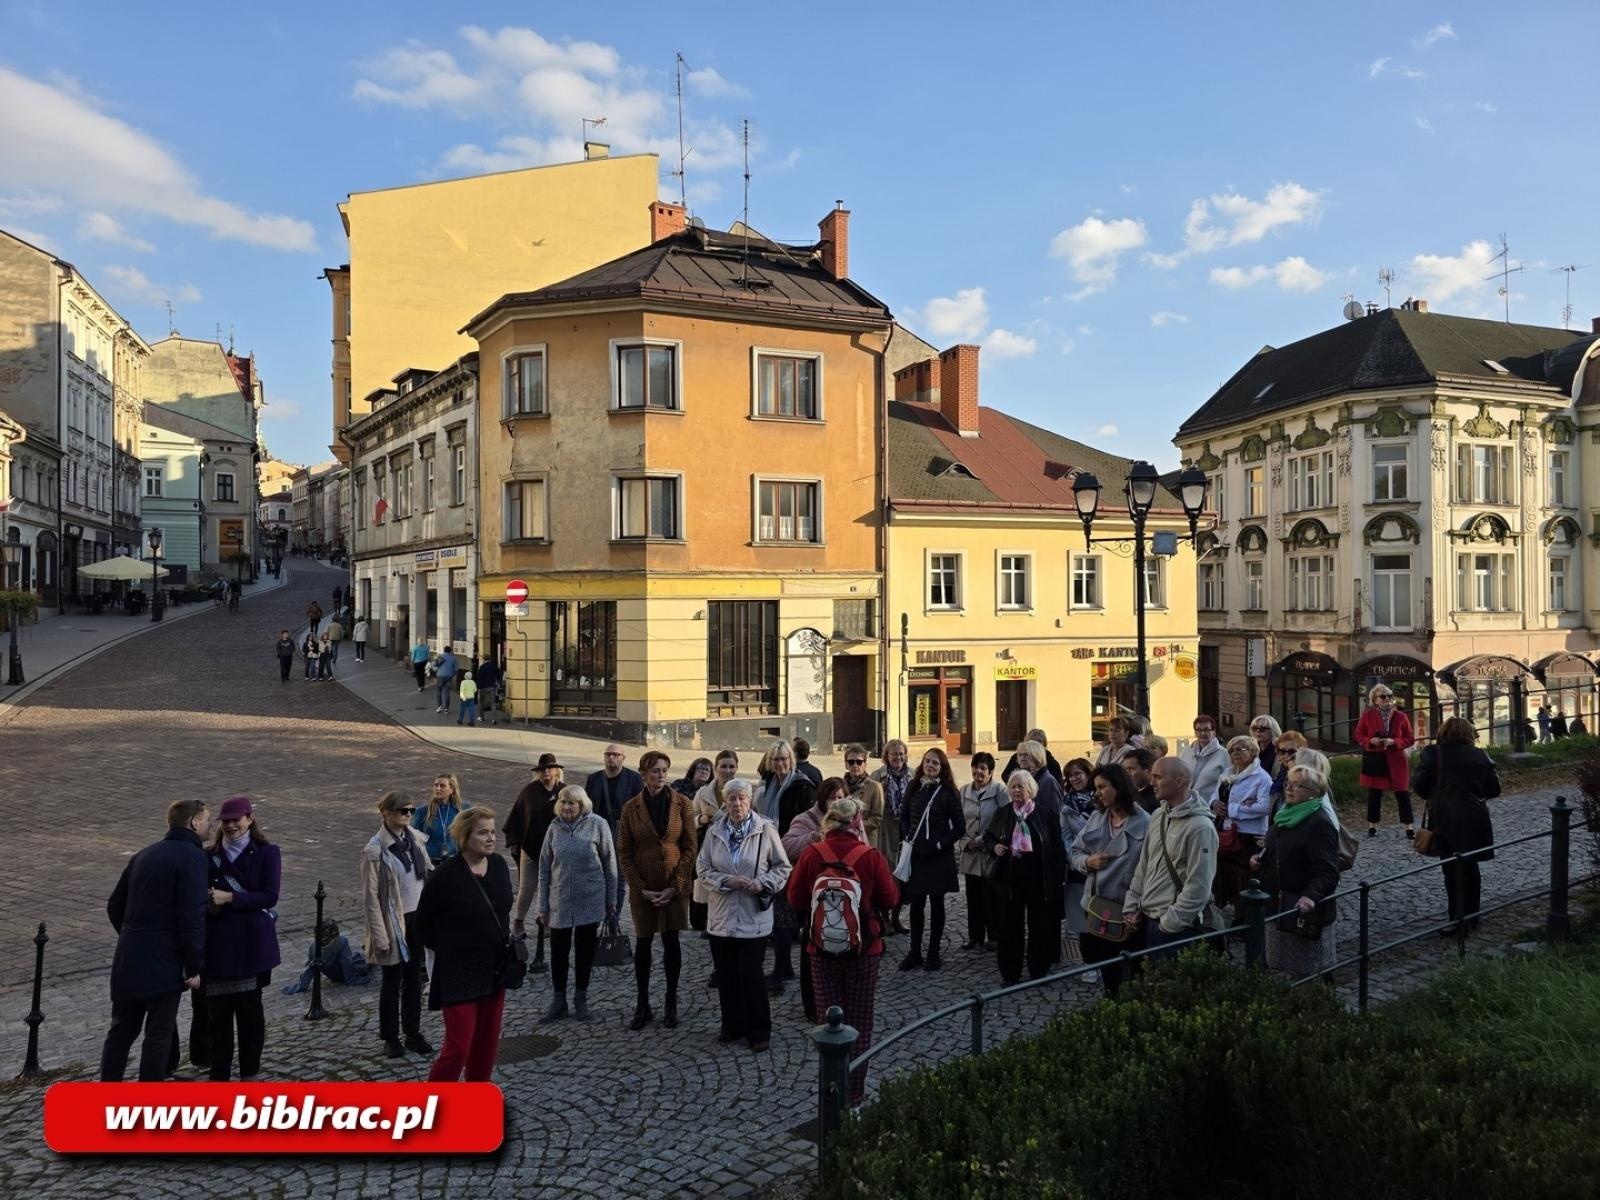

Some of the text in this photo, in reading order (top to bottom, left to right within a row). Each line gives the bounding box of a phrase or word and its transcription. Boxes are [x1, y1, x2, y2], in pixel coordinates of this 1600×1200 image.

[916, 649, 966, 663] KANTOR
[1098, 646, 1140, 658] KANTO
[997, 667, 1036, 676] KANTOR
